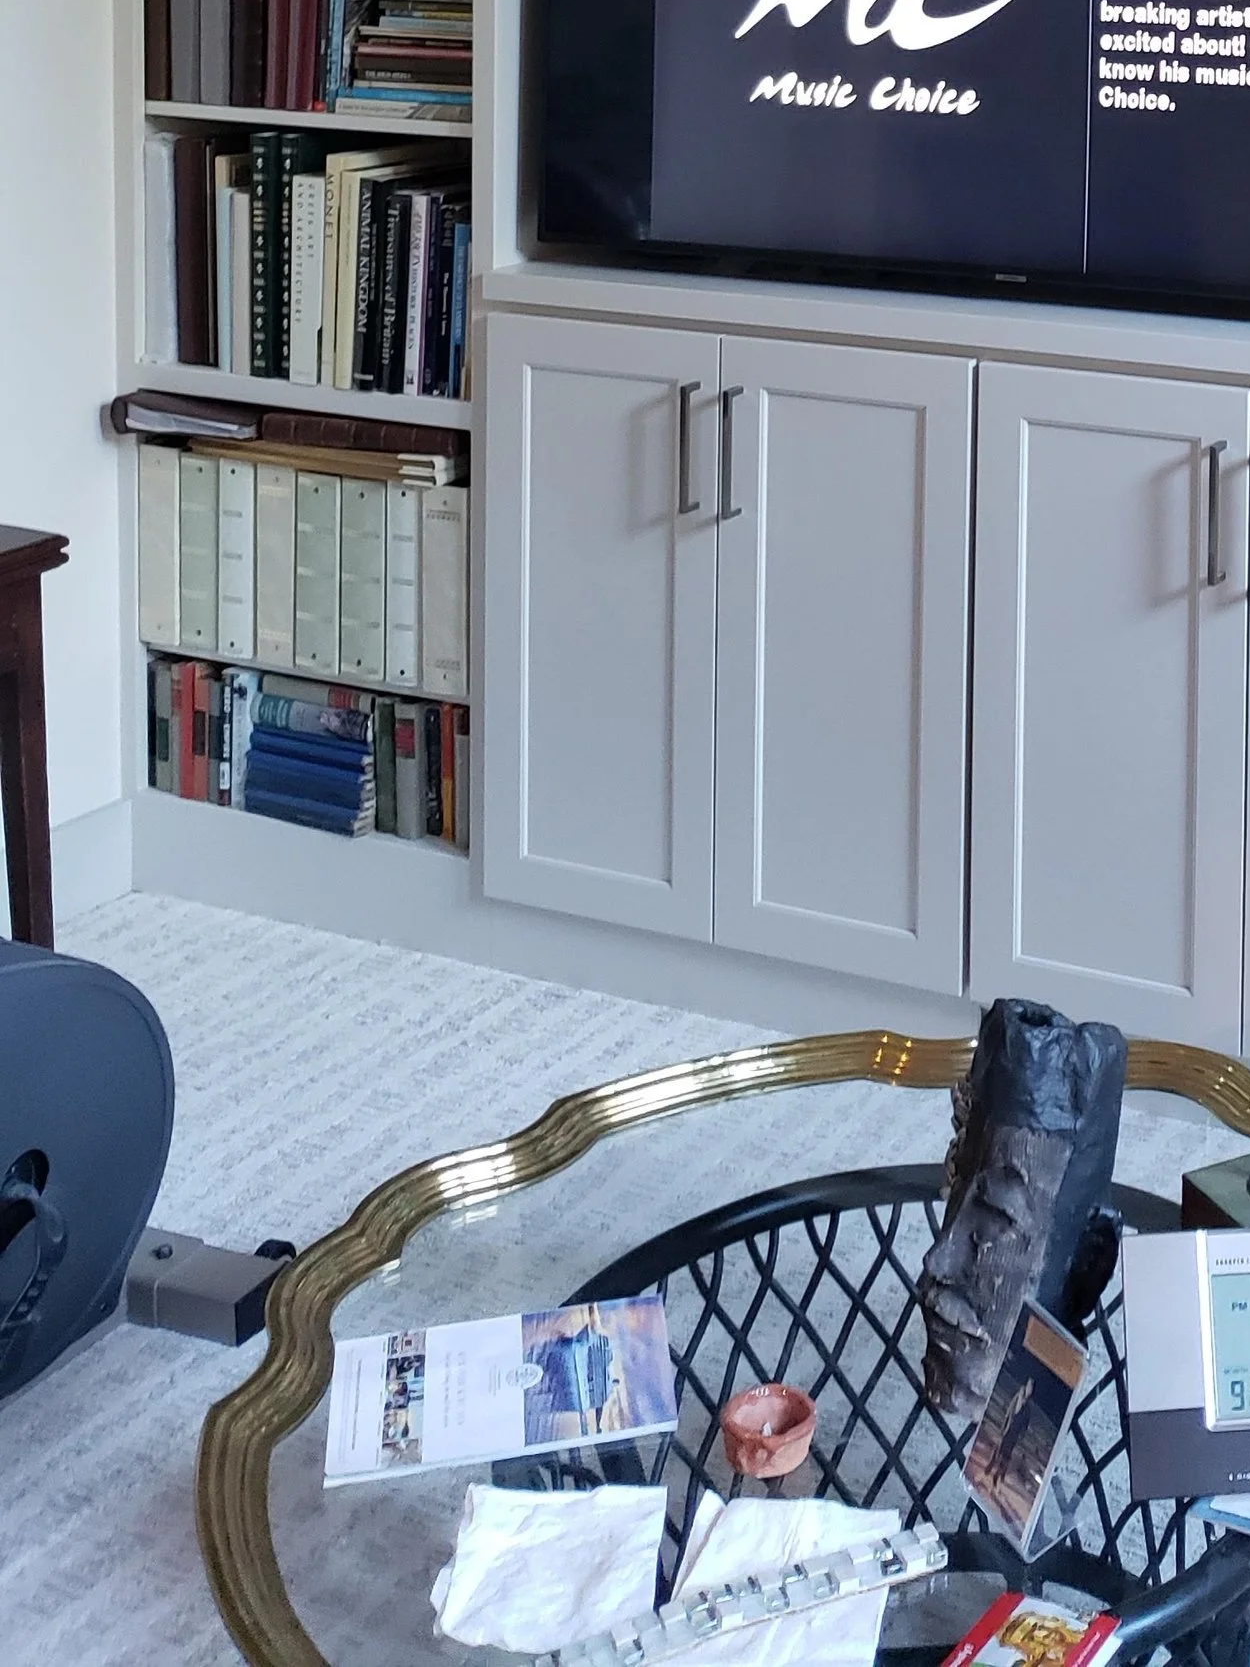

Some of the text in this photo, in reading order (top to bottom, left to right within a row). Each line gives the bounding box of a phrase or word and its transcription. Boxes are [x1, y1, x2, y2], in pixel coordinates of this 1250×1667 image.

[1099, 0, 1191, 31] breaking
[1099, 30, 1176, 54] excited
[1180, 32, 1247, 57] about!
[1098, 57, 1155, 81] know
[1159, 60, 1190, 83] his
[749, 71, 981, 116] Music Choice
[1098, 85, 1177, 112] Choice.
[307, 183, 315, 259] GREEK ART
[324, 173, 335, 240] MONET
[294, 182, 304, 324] AND ARCHITECTURE
[356, 188, 372, 333] ANIMAL KINGDOM
[380, 203, 401, 365] Treasures of Britain
[1231, 1302, 1248, 1312] PM
